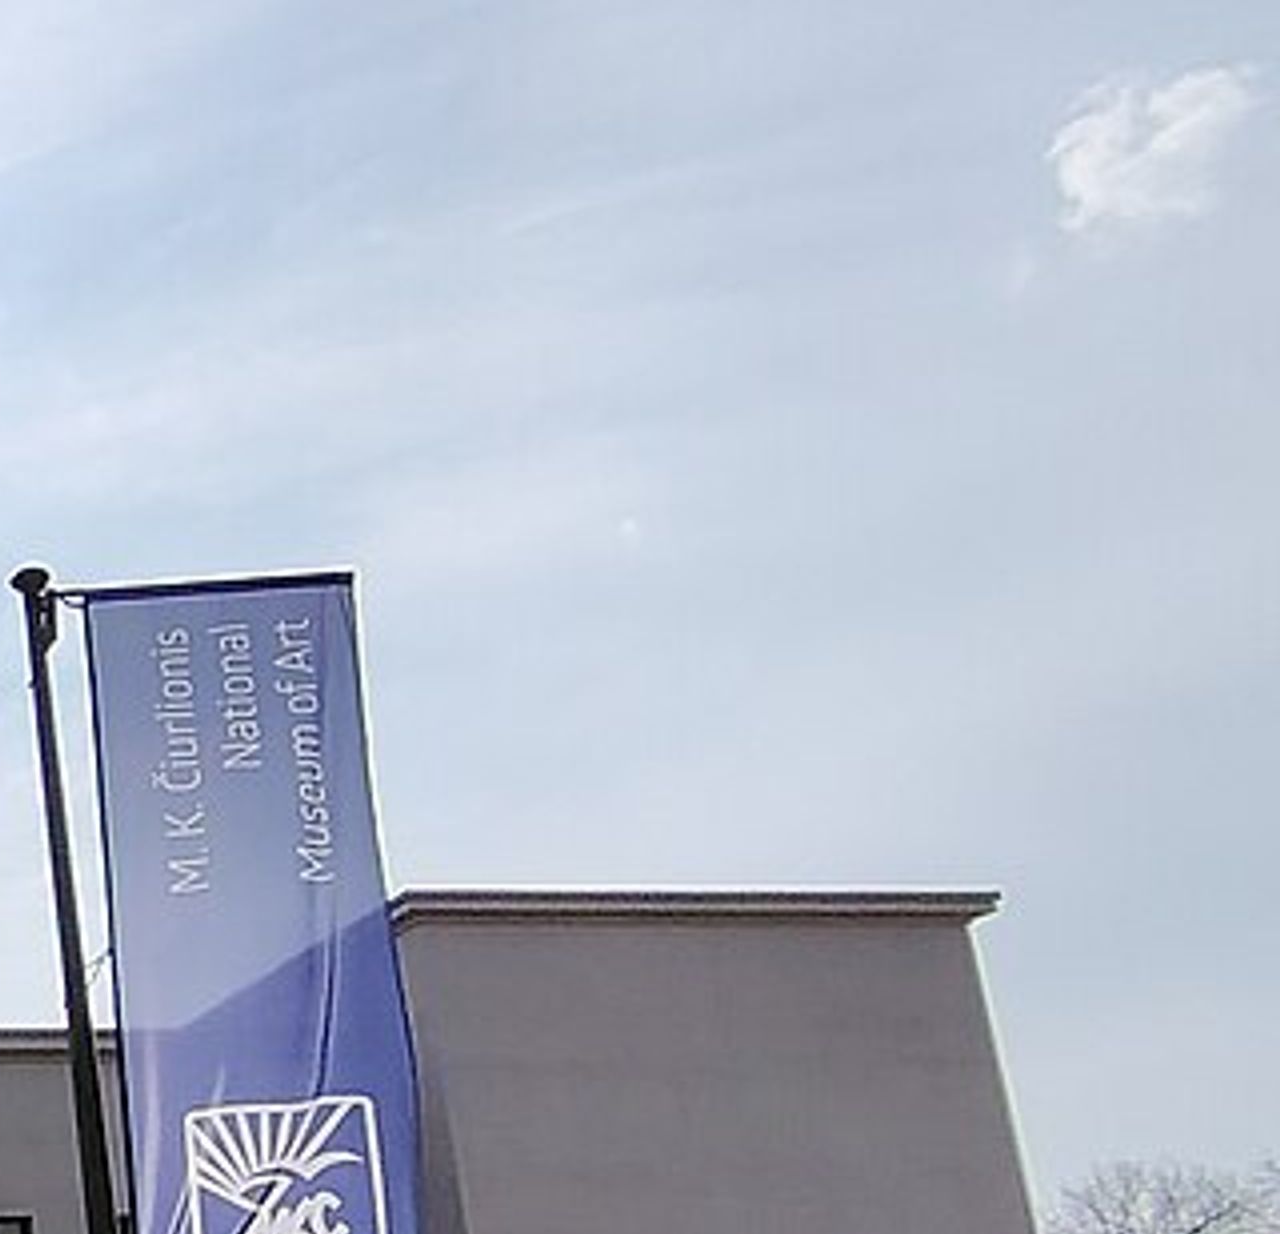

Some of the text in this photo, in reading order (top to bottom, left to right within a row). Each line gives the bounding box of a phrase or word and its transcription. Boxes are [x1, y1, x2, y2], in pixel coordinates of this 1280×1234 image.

[149, 626, 210, 895] M. K. Čiurlionis
[206, 621, 262, 771] National
[272, 616, 335, 882] Museum of Art
